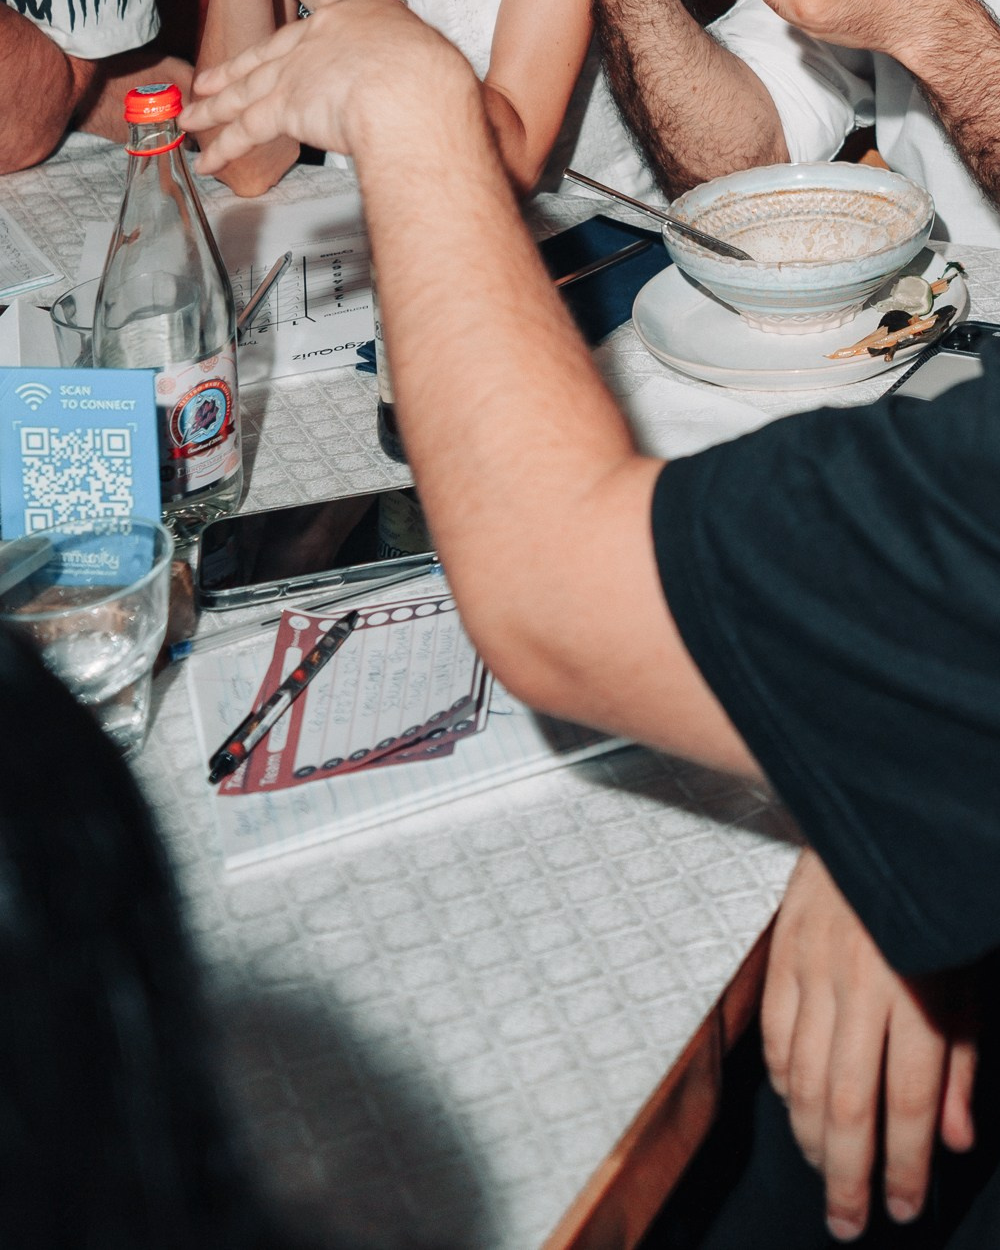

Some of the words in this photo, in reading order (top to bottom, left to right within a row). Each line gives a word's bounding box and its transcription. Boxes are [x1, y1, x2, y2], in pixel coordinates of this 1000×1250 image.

[292, 341, 367, 361] zgoQuiz
[60, 385, 91, 396] SCAN
[61, 401, 77, 410] TO
[80, 401, 136, 411] CONNECT
